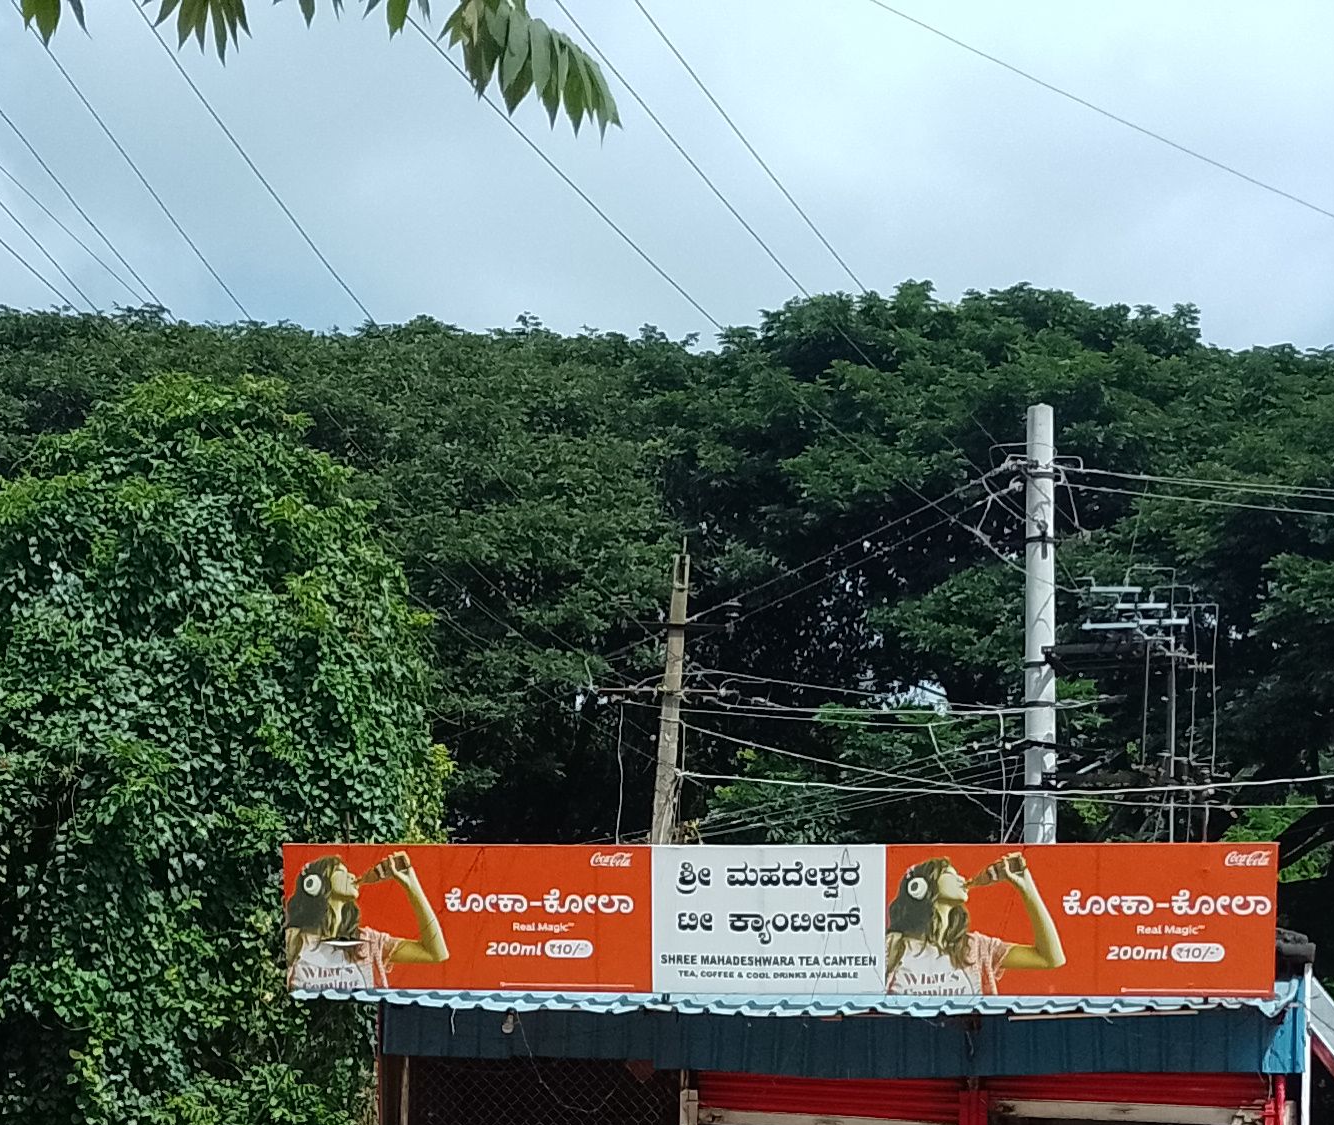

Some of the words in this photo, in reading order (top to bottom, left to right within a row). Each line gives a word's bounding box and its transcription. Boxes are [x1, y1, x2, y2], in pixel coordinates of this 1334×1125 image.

[675, 861, 712, 895] ಶ್ರೀ
[726, 861, 861, 899] ಮಹದೇಶ್ವರ
[444, 887, 634, 914] ಕೋಕಾ-ಕೋಲಾ
[1062, 889, 1272, 917] ಕೋಕಾ-ಕೋಲಾ
[512, 922, 536, 932] Real
[677, 911, 713, 932] ಟೀ
[728, 907, 861, 945] ಕ್ಯಾಂಟೀನ್
[1136, 925, 1162, 935] Real
[485, 941, 543, 957] 200ml
[1105, 945, 1169, 960] 200ml
[660, 954, 698, 966] SHREE
[700, 954, 796, 967] MAHADESHWARA
[798, 956, 821, 967] TEA
[823, 956, 878, 967] CANTEEN
[700, 970, 735, 979] COFFEE
[746, 971, 772, 980] COOL
[773, 971, 808, 980] DRINKS
[809, 971, 859, 980] AVAILABLE
